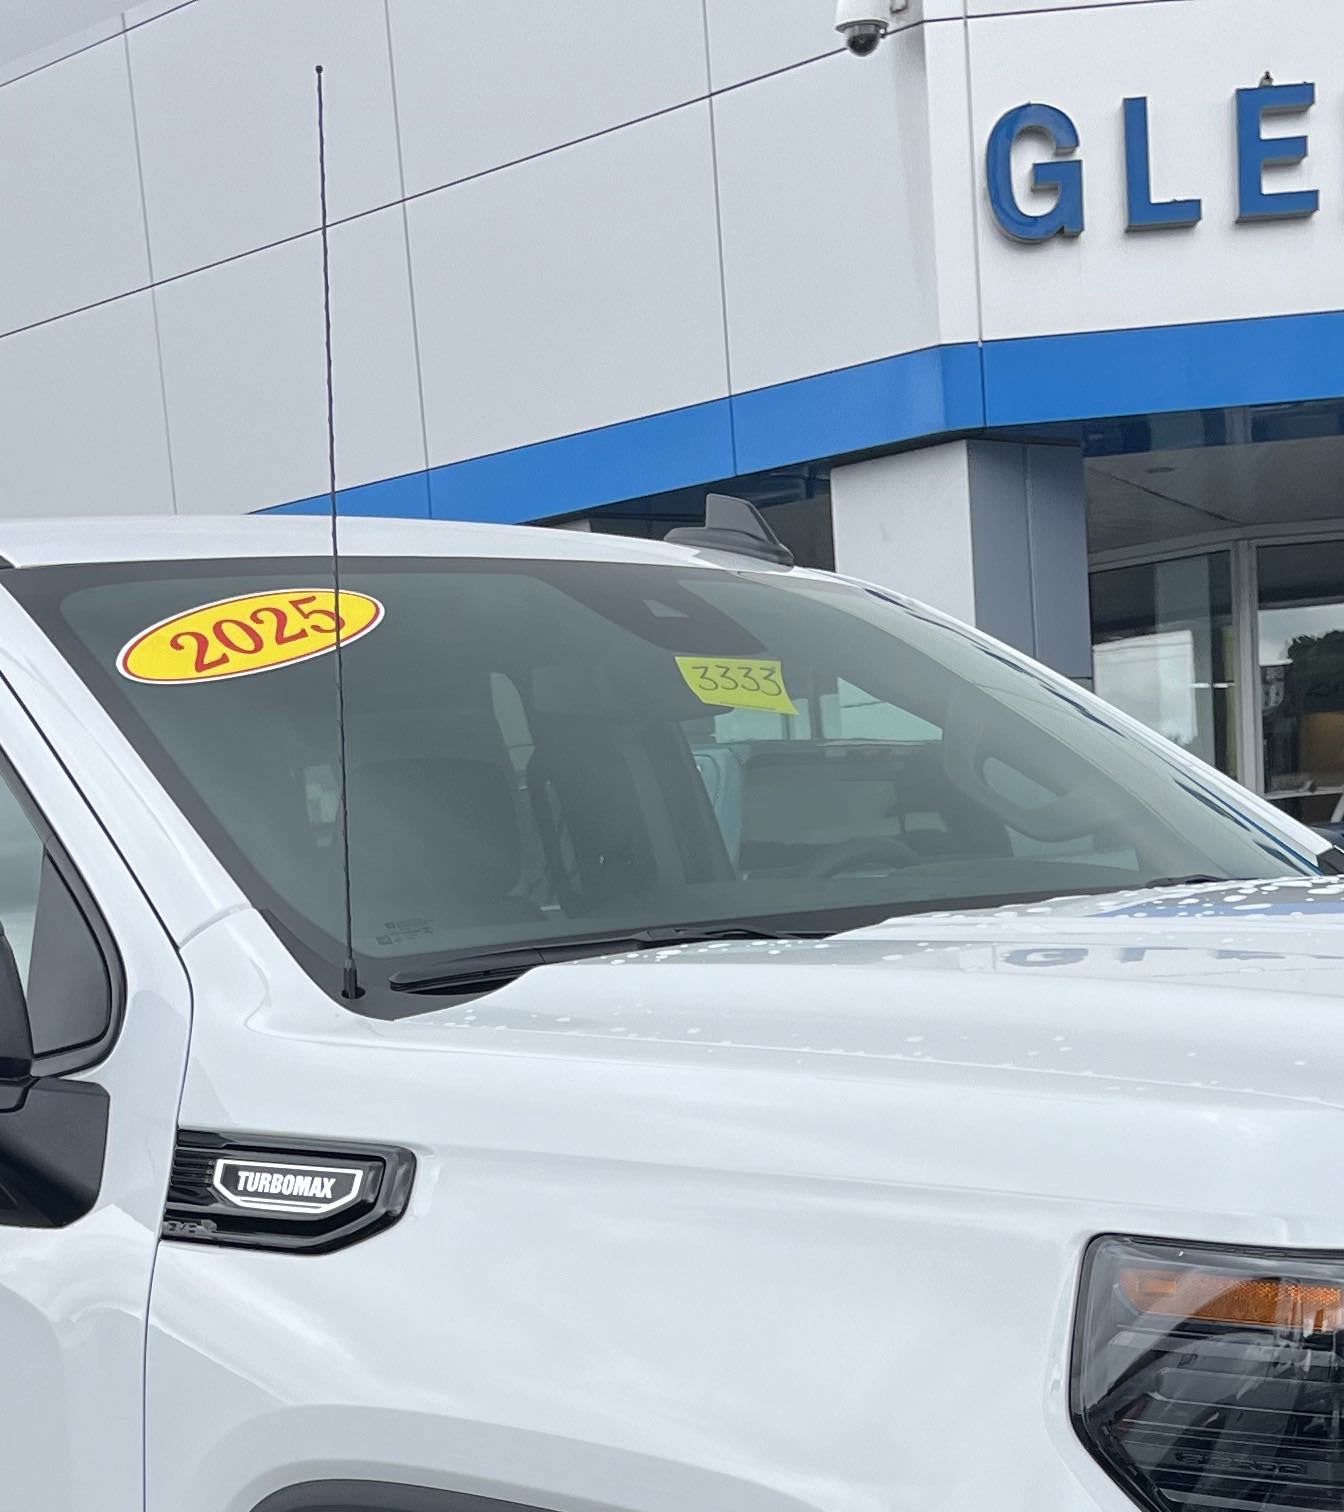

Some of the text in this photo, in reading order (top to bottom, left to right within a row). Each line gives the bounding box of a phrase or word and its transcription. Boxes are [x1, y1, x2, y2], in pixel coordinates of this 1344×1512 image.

[170, 594, 347, 674] 2025
[690, 664, 783, 697] 3333
[236, 1171, 336, 1199] TURBOMAX
